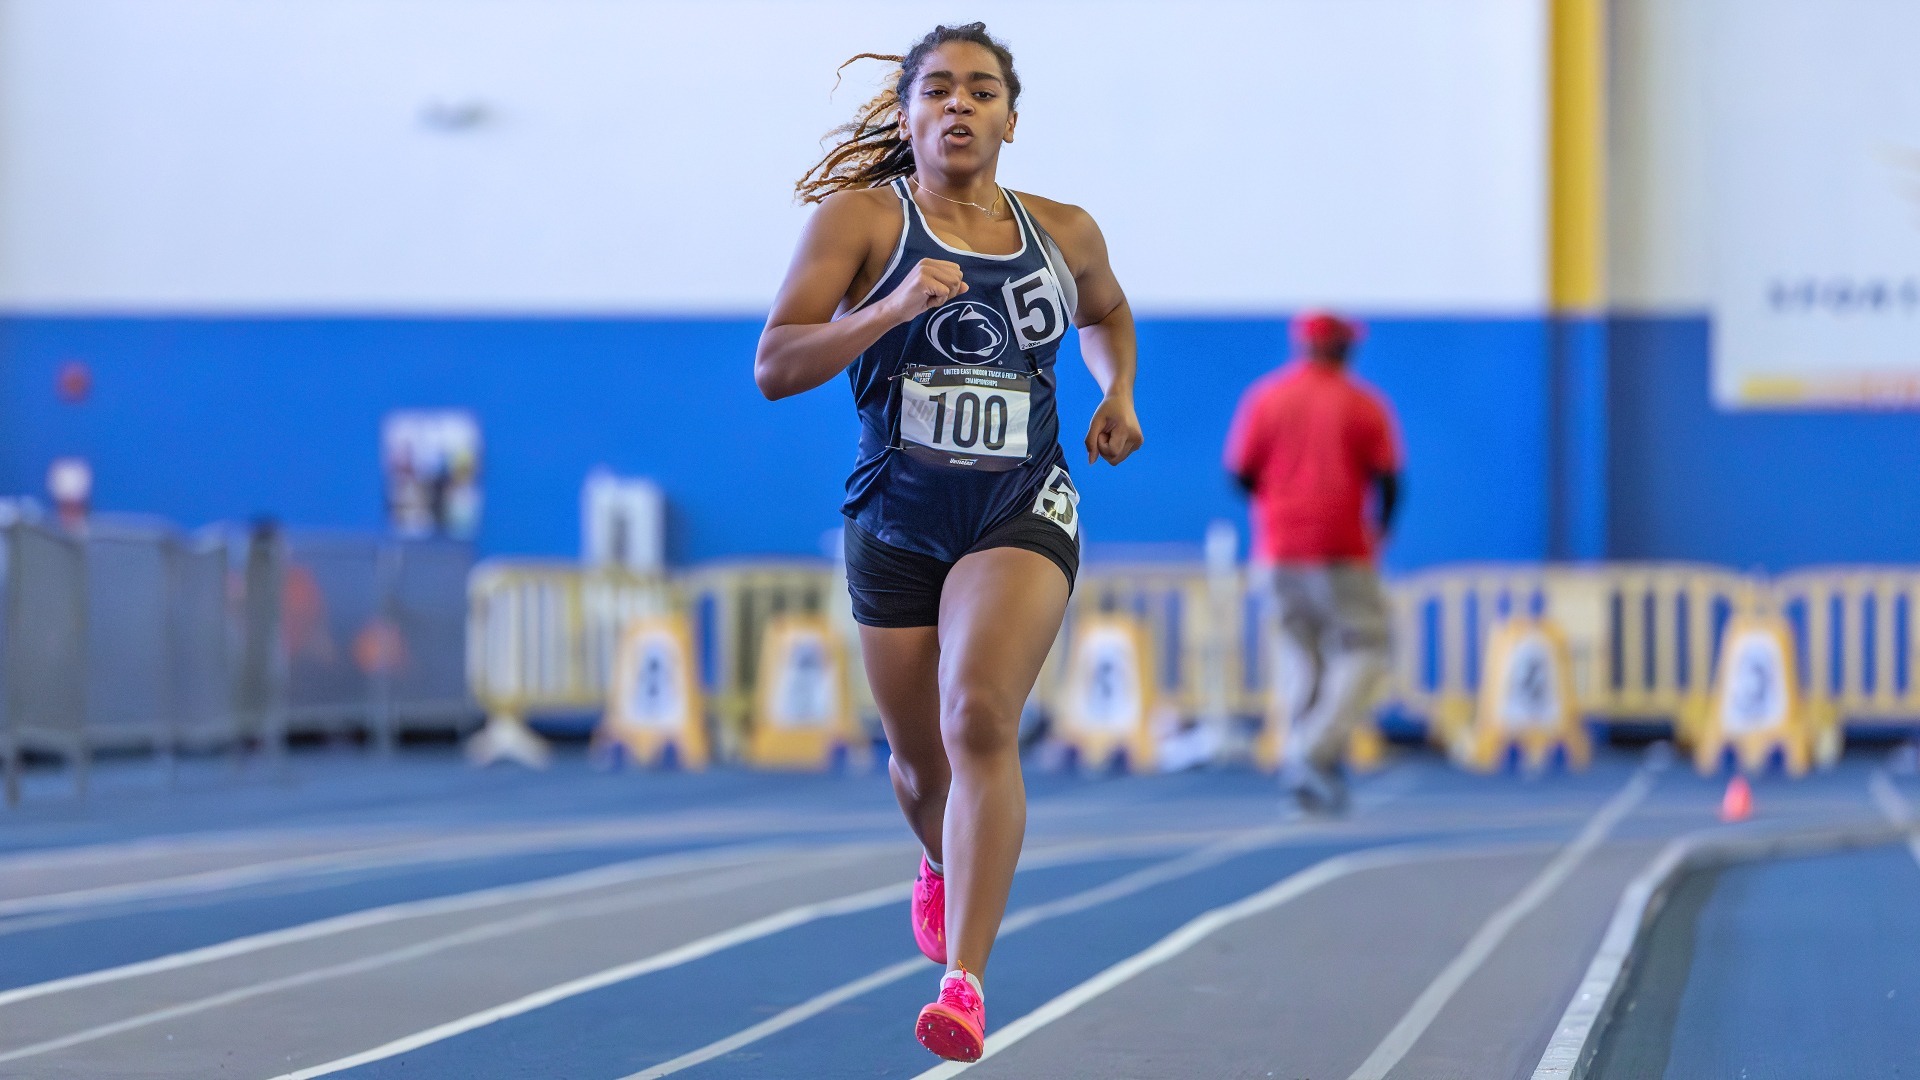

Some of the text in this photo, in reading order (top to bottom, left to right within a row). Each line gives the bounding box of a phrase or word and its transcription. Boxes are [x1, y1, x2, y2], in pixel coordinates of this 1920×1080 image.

[1012, 276, 1056, 341] 5
[943, 368, 960, 376] UNITED
[972, 369, 988, 377] INDOOR
[988, 370, 1001, 378] TRACK
[1005, 372, 1017, 380] FIELD
[964, 377, 998, 387] CHAMPIONSHIPS
[929, 391, 1008, 451] 100
[1043, 470, 1077, 525] 5
